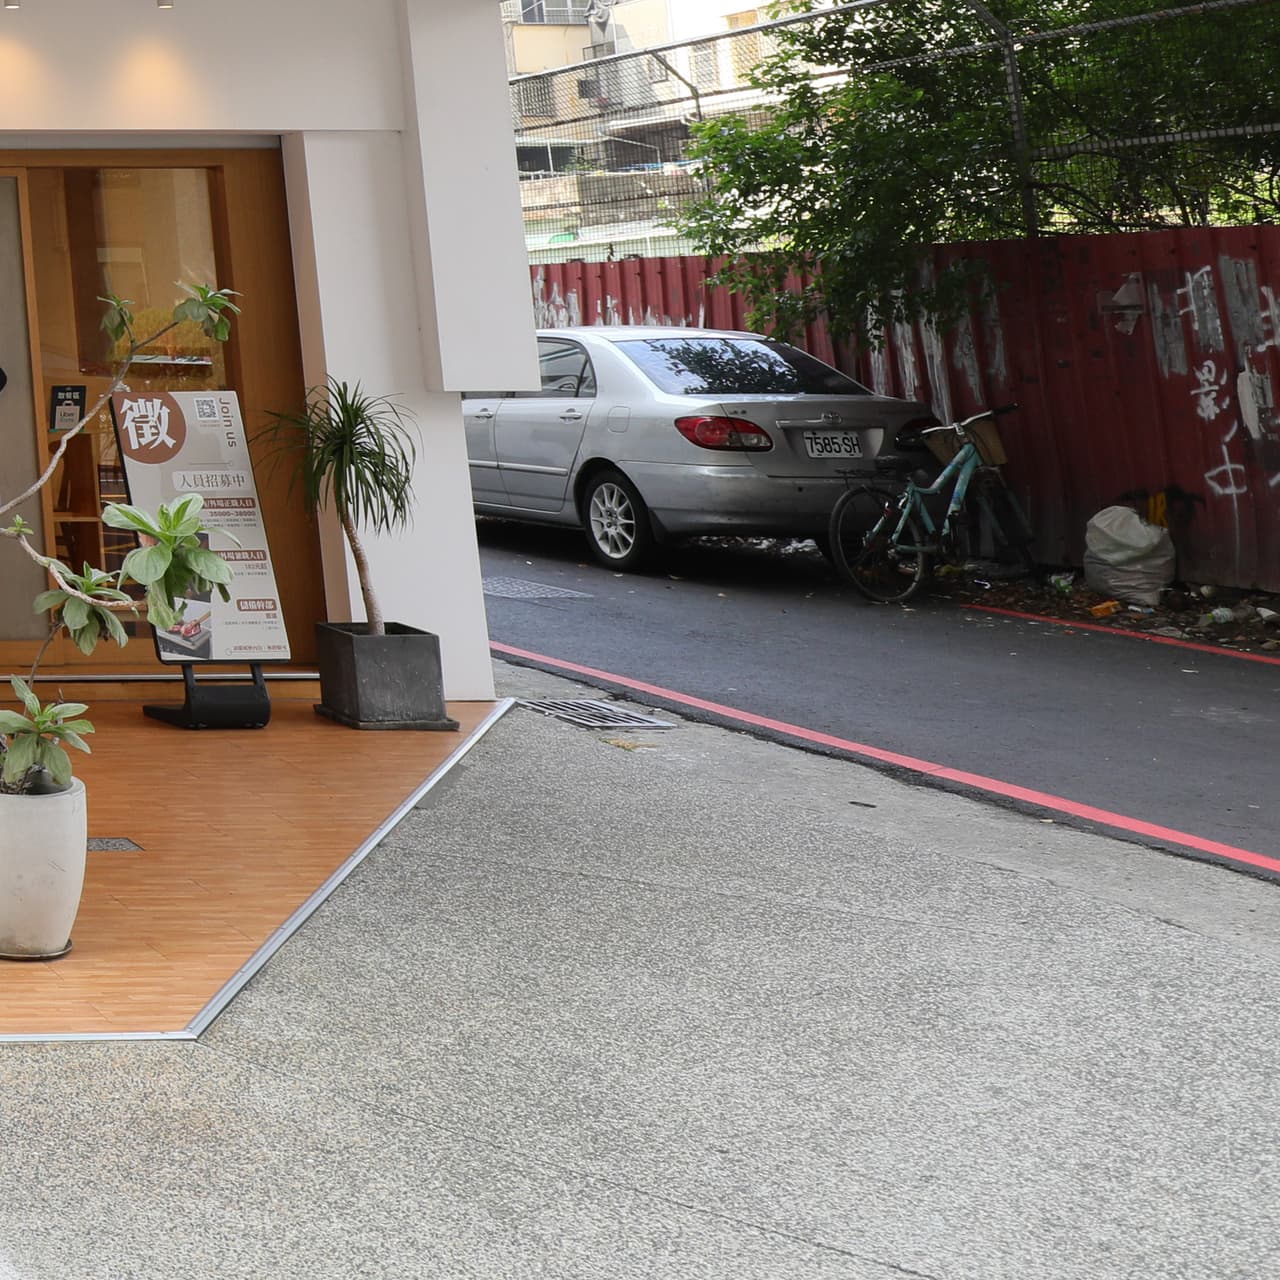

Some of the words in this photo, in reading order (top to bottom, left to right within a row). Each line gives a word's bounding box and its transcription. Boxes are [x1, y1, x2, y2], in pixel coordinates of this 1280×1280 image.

[120, 396, 177, 451] 徵
[219, 397, 234, 428] Join
[226, 431, 237, 448] us
[180, 473, 246, 489] 人員招募中
